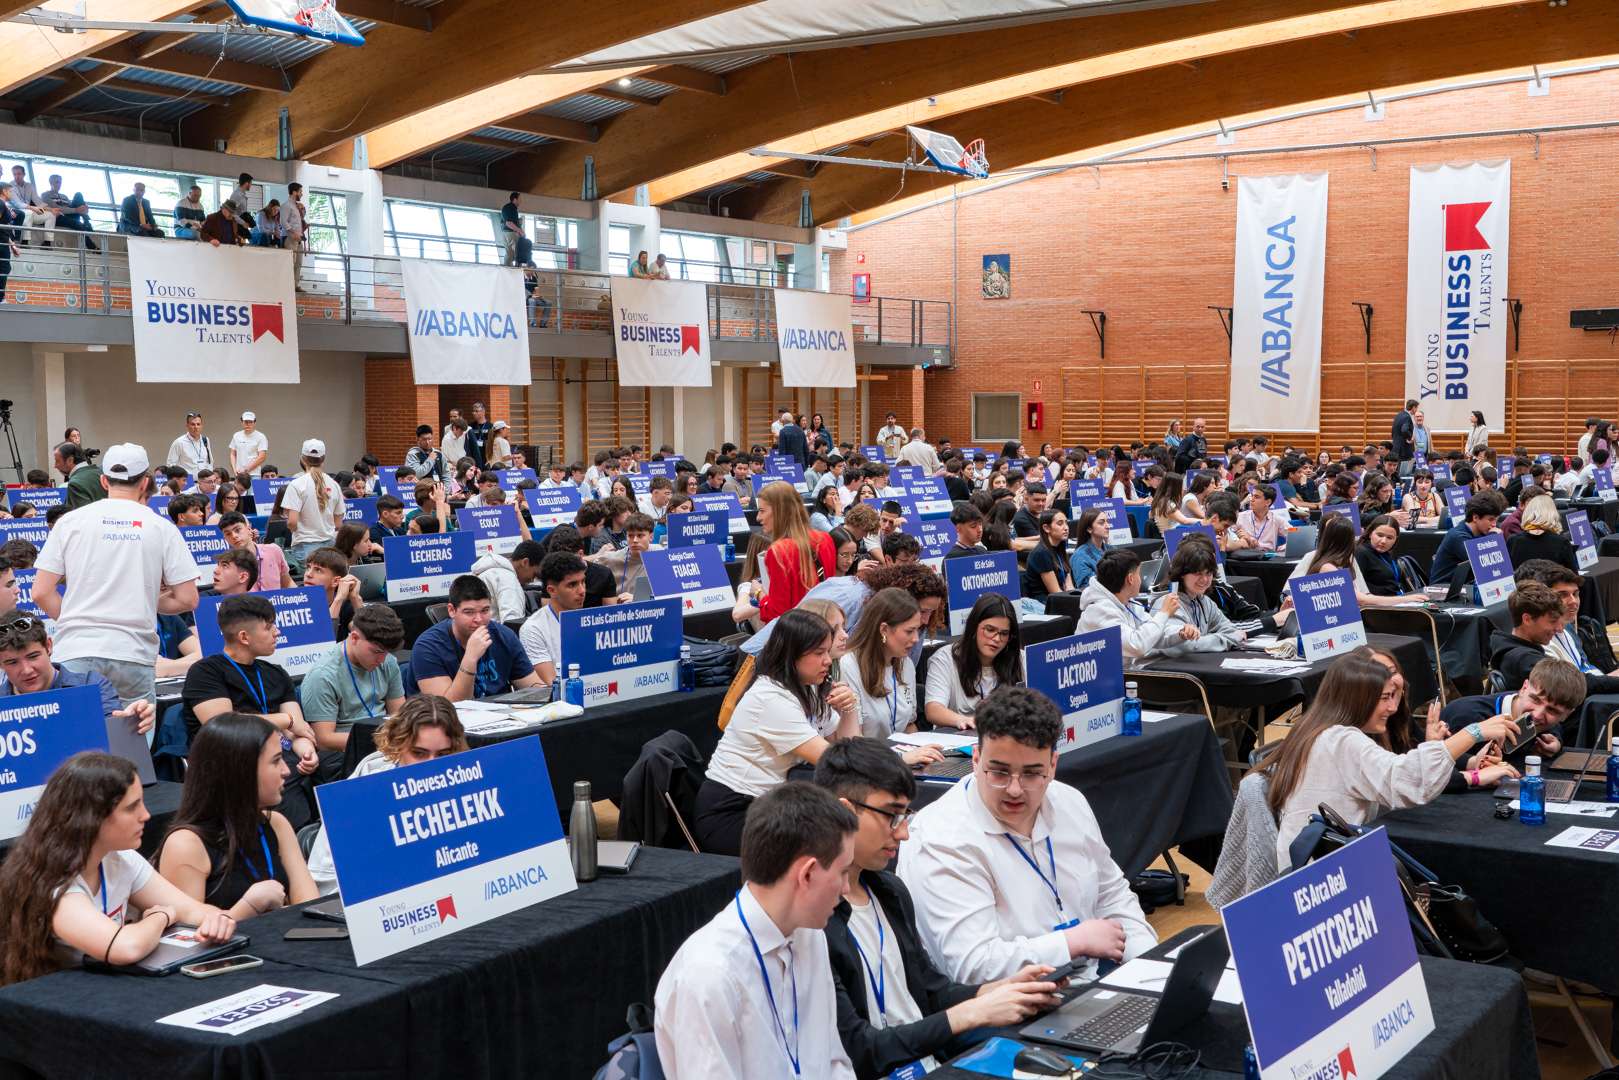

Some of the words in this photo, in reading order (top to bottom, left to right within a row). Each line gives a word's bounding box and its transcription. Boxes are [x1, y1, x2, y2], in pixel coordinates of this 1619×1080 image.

[146, 280, 197, 297] YOUNG
[1473, 253, 1493, 334] TALENTS
[147, 302, 250, 326] BUSINESS
[620, 307, 649, 322] YOUNG
[196, 328, 251, 344] TALENTS
[621, 325, 681, 343] BUSINESS
[1445, 254, 1471, 400] BUSINESS
[1420, 333, 1440, 400] YOUNG
[683, 524, 715, 536] POLIREMUU
[409, 539, 426, 548] Colegio
[426, 538, 439, 546] Santa
[410, 548, 452, 563] LECHERAS
[423, 565, 442, 573] Palencia
[962, 571, 1008, 591] OKTOMORROW
[275, 607, 314, 629] MENTE
[581, 615, 591, 628] IES
[592, 614, 604, 626] Luis
[605, 611, 626, 625] Carrillo
[626, 611, 635, 621] de
[635, 607, 666, 620] Sotomayor
[595, 624, 653, 650] KALILINUX
[612, 652, 638, 666] Córdoba
[1045, 650, 1055, 664] IES
[1055, 647, 1070, 662] Duque
[1069, 646, 1076, 657] de
[1057, 659, 1097, 689] LACTORO
[1069, 691, 1089, 709] Segovia
[392, 781, 408, 800] La
[408, 771, 448, 797] Devesa
[448, 761, 483, 787] School
[389, 787, 504, 847] LECHELEKK
[435, 841, 479, 868] Alicante
[1294, 888, 1311, 915] IES
[1312, 880, 1331, 907] Arca
[1328, 866, 1347, 898] Real
[383, 904, 437, 933] BUSINESS
[1282, 896, 1378, 986] PETITCREAM
[1325, 965, 1367, 1010] Valladolid
